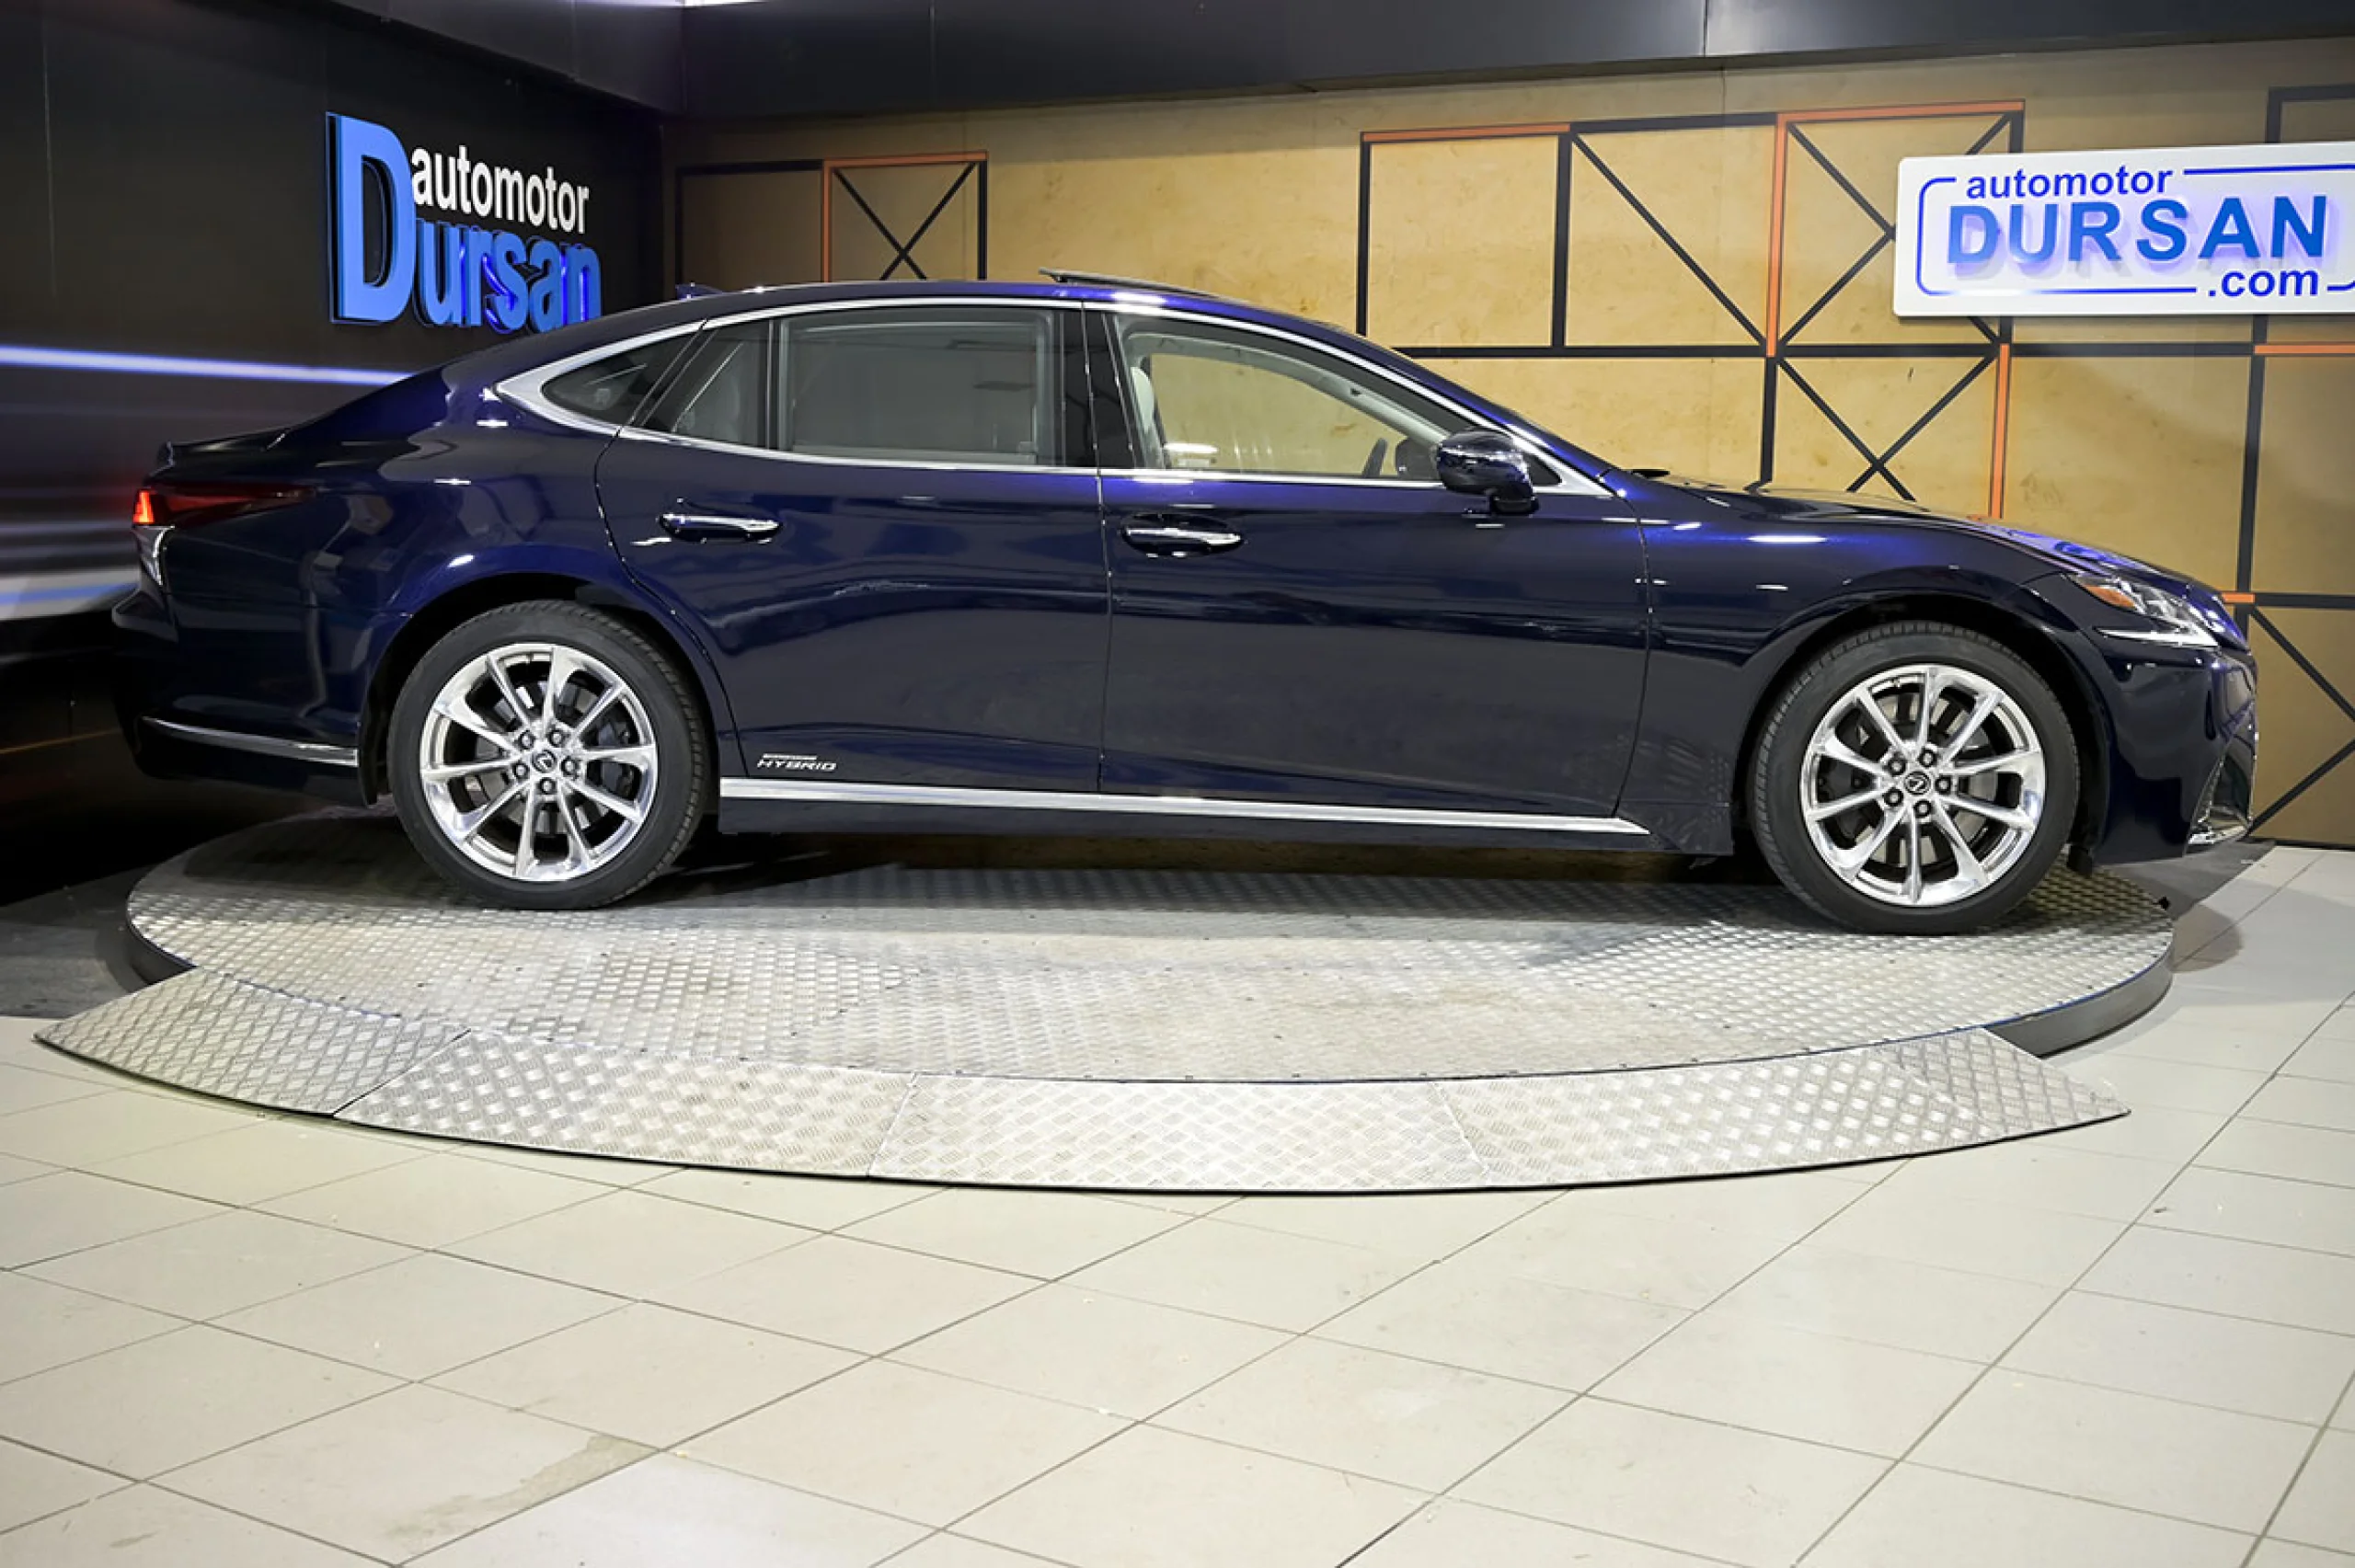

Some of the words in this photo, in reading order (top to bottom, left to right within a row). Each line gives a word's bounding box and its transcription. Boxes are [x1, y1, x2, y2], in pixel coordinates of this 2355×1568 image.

[411, 144, 590, 235] automotor
[1966, 166, 2174, 200] automotor
[326, 110, 602, 335] Dursan
[1947, 195, 2327, 265] DURSAN
[2208, 268, 2319, 297] .com
